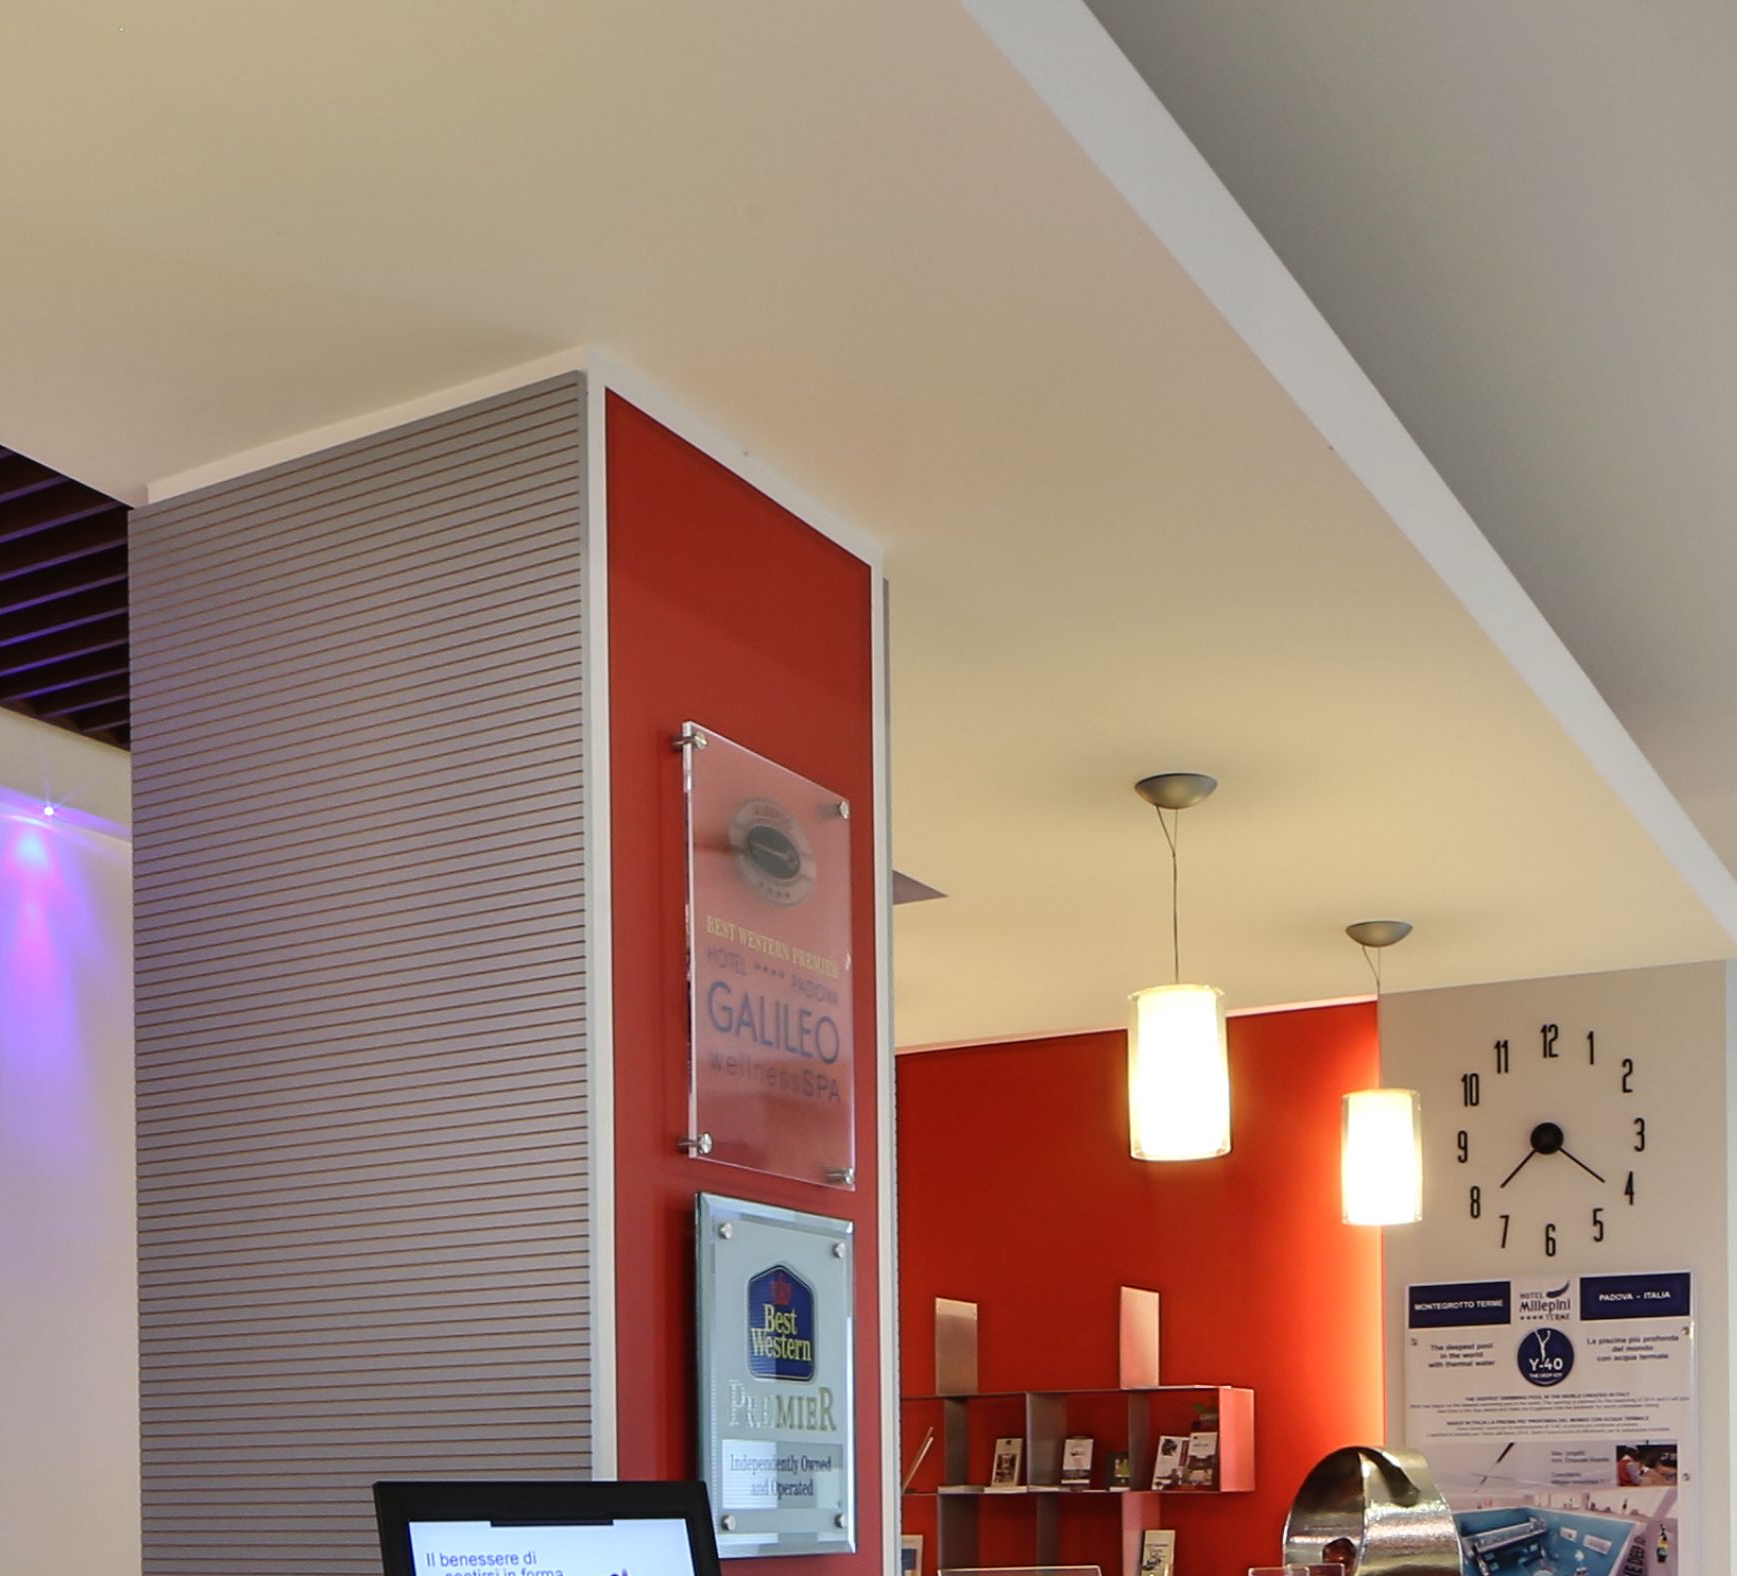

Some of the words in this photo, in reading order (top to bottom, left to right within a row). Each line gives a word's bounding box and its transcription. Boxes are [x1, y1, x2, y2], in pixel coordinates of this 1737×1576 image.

[707, 915, 735, 941] BEST
[738, 926, 790, 961] WESTERN
[791, 946, 840, 978] PREMIER
[707, 945, 747, 976] HOTEL
[707, 980, 840, 1064] GALILEO
[1494, 1039, 1509, 1074] 11
[1540, 1024, 1559, 1058] 12
[1587, 1030, 1594, 1065] 1
[1461, 1073, 1480, 1106] 10
[1622, 1058, 1633, 1093] 2
[1457, 1130, 1468, 1163] 9
[1634, 1118, 1645, 1151] 3
[1470, 1186, 1481, 1219] 8
[1624, 1171, 1635, 1205] 4
[1499, 1215, 1510, 1248] 7
[1545, 1223, 1556, 1257] 6
[1593, 1208, 1604, 1242] 5
[1414, 1302, 1475, 1310] MONTEGROTTO
[1476, 1300, 1504, 1308] TERME
[1519, 1299, 1571, 1314] Millepini
[1598, 1293, 1634, 1301] PADOVA
[1643, 1291, 1671, 1299] ITALIA
[763, 1303, 798, 1336] Best
[751, 1327, 812, 1361] Western
[1446, 1343, 1475, 1351] deepest
[1476, 1342, 1494, 1350] pool
[1598, 1337, 1627, 1345] piscina
[1643, 1335, 1679, 1343] profonda
[1529, 1357, 1563, 1371] Y-40
[728, 1379, 837, 1432] PREMIER
[730, 1454, 799, 1475] Independently
[800, 1455, 832, 1472] Owned
[751, 1480, 769, 1496] and
[771, 1479, 814, 1500] Operated
[426, 1552, 436, 1567] Il
[439, 1552, 519, 1567] benessere
[523, 1551, 537, 1565] di
